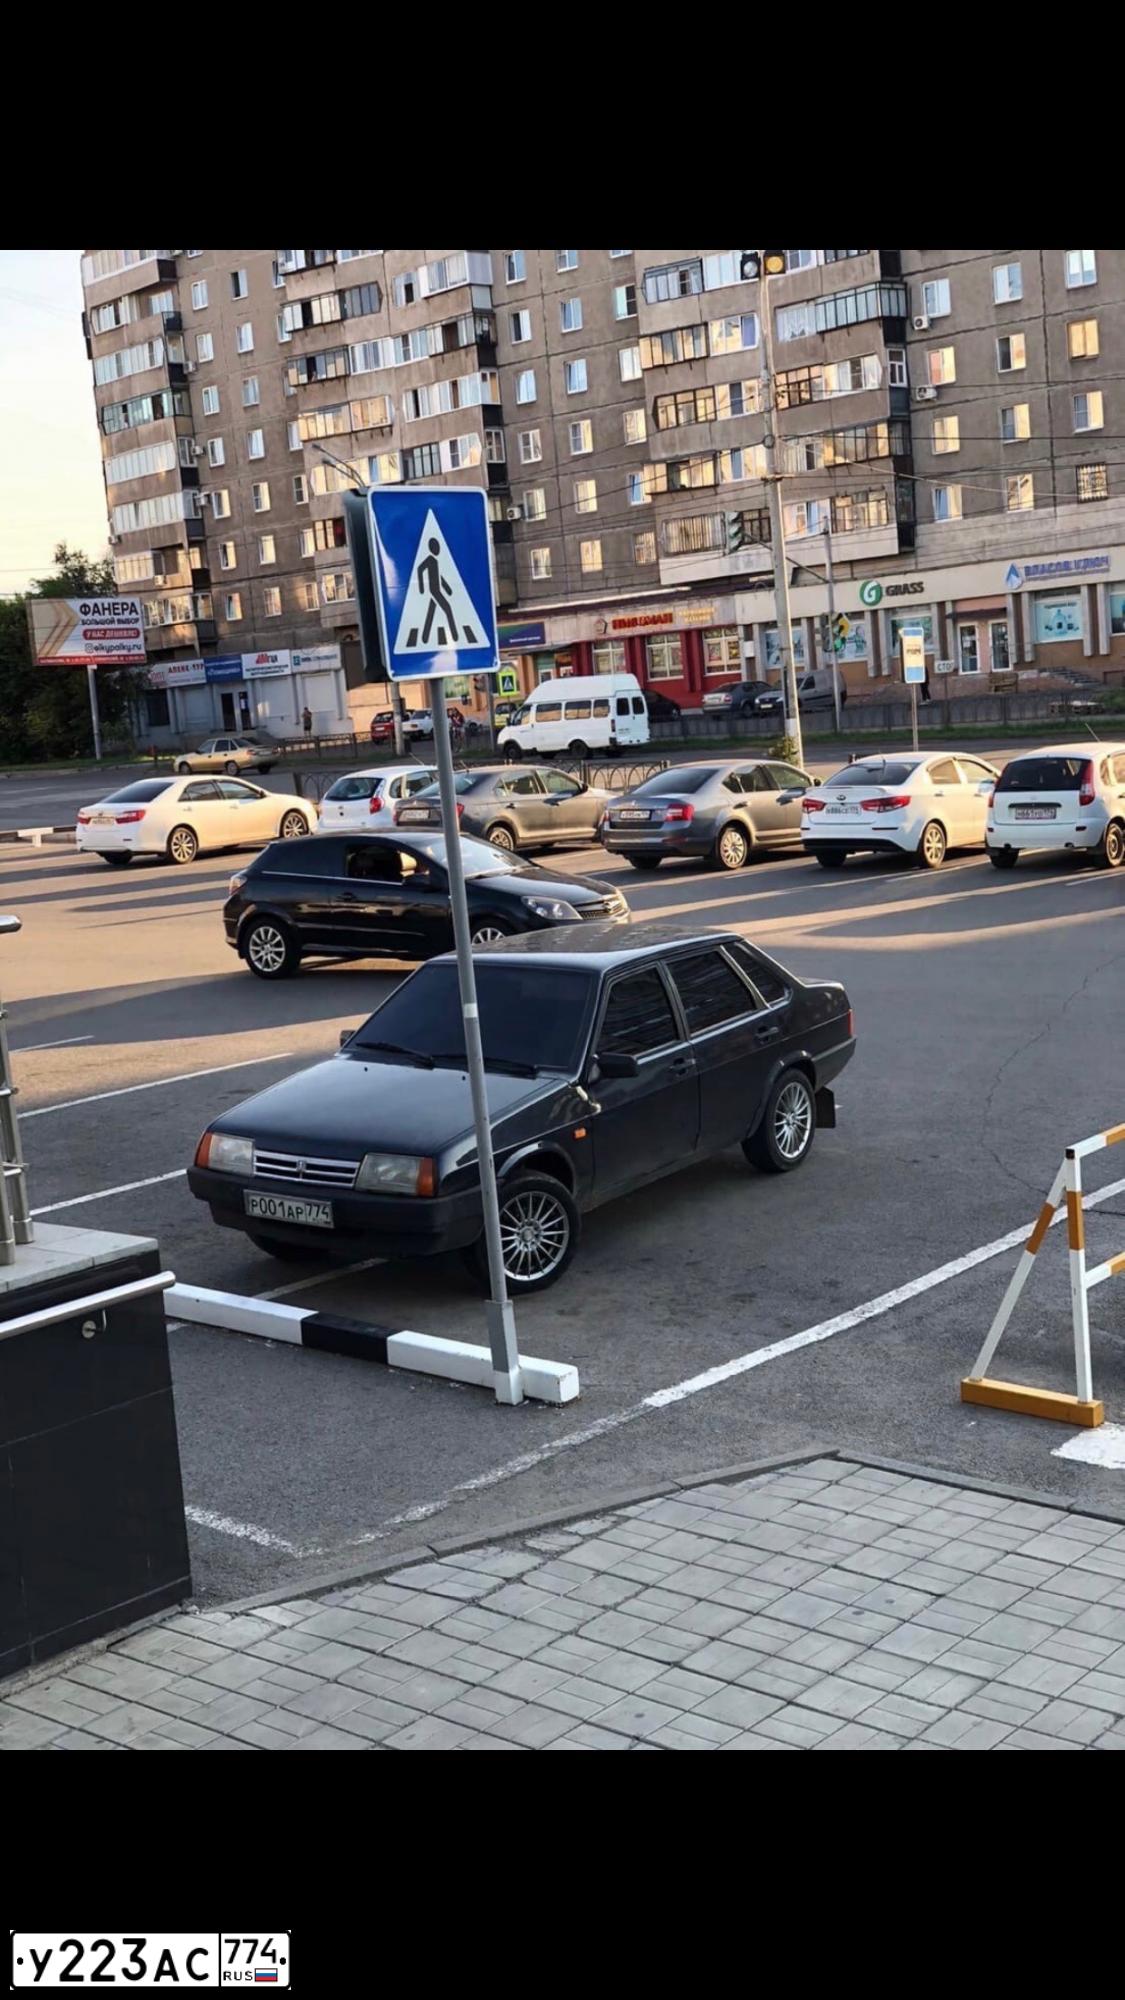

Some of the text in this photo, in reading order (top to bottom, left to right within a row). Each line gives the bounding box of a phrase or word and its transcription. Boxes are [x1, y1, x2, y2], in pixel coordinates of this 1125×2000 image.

[885, 581, 925, 596] GRASS
[79, 601, 139, 617] ФАНЕРА
[81, 616, 140, 626] БОЛЬШОЙ ВЫБОР
